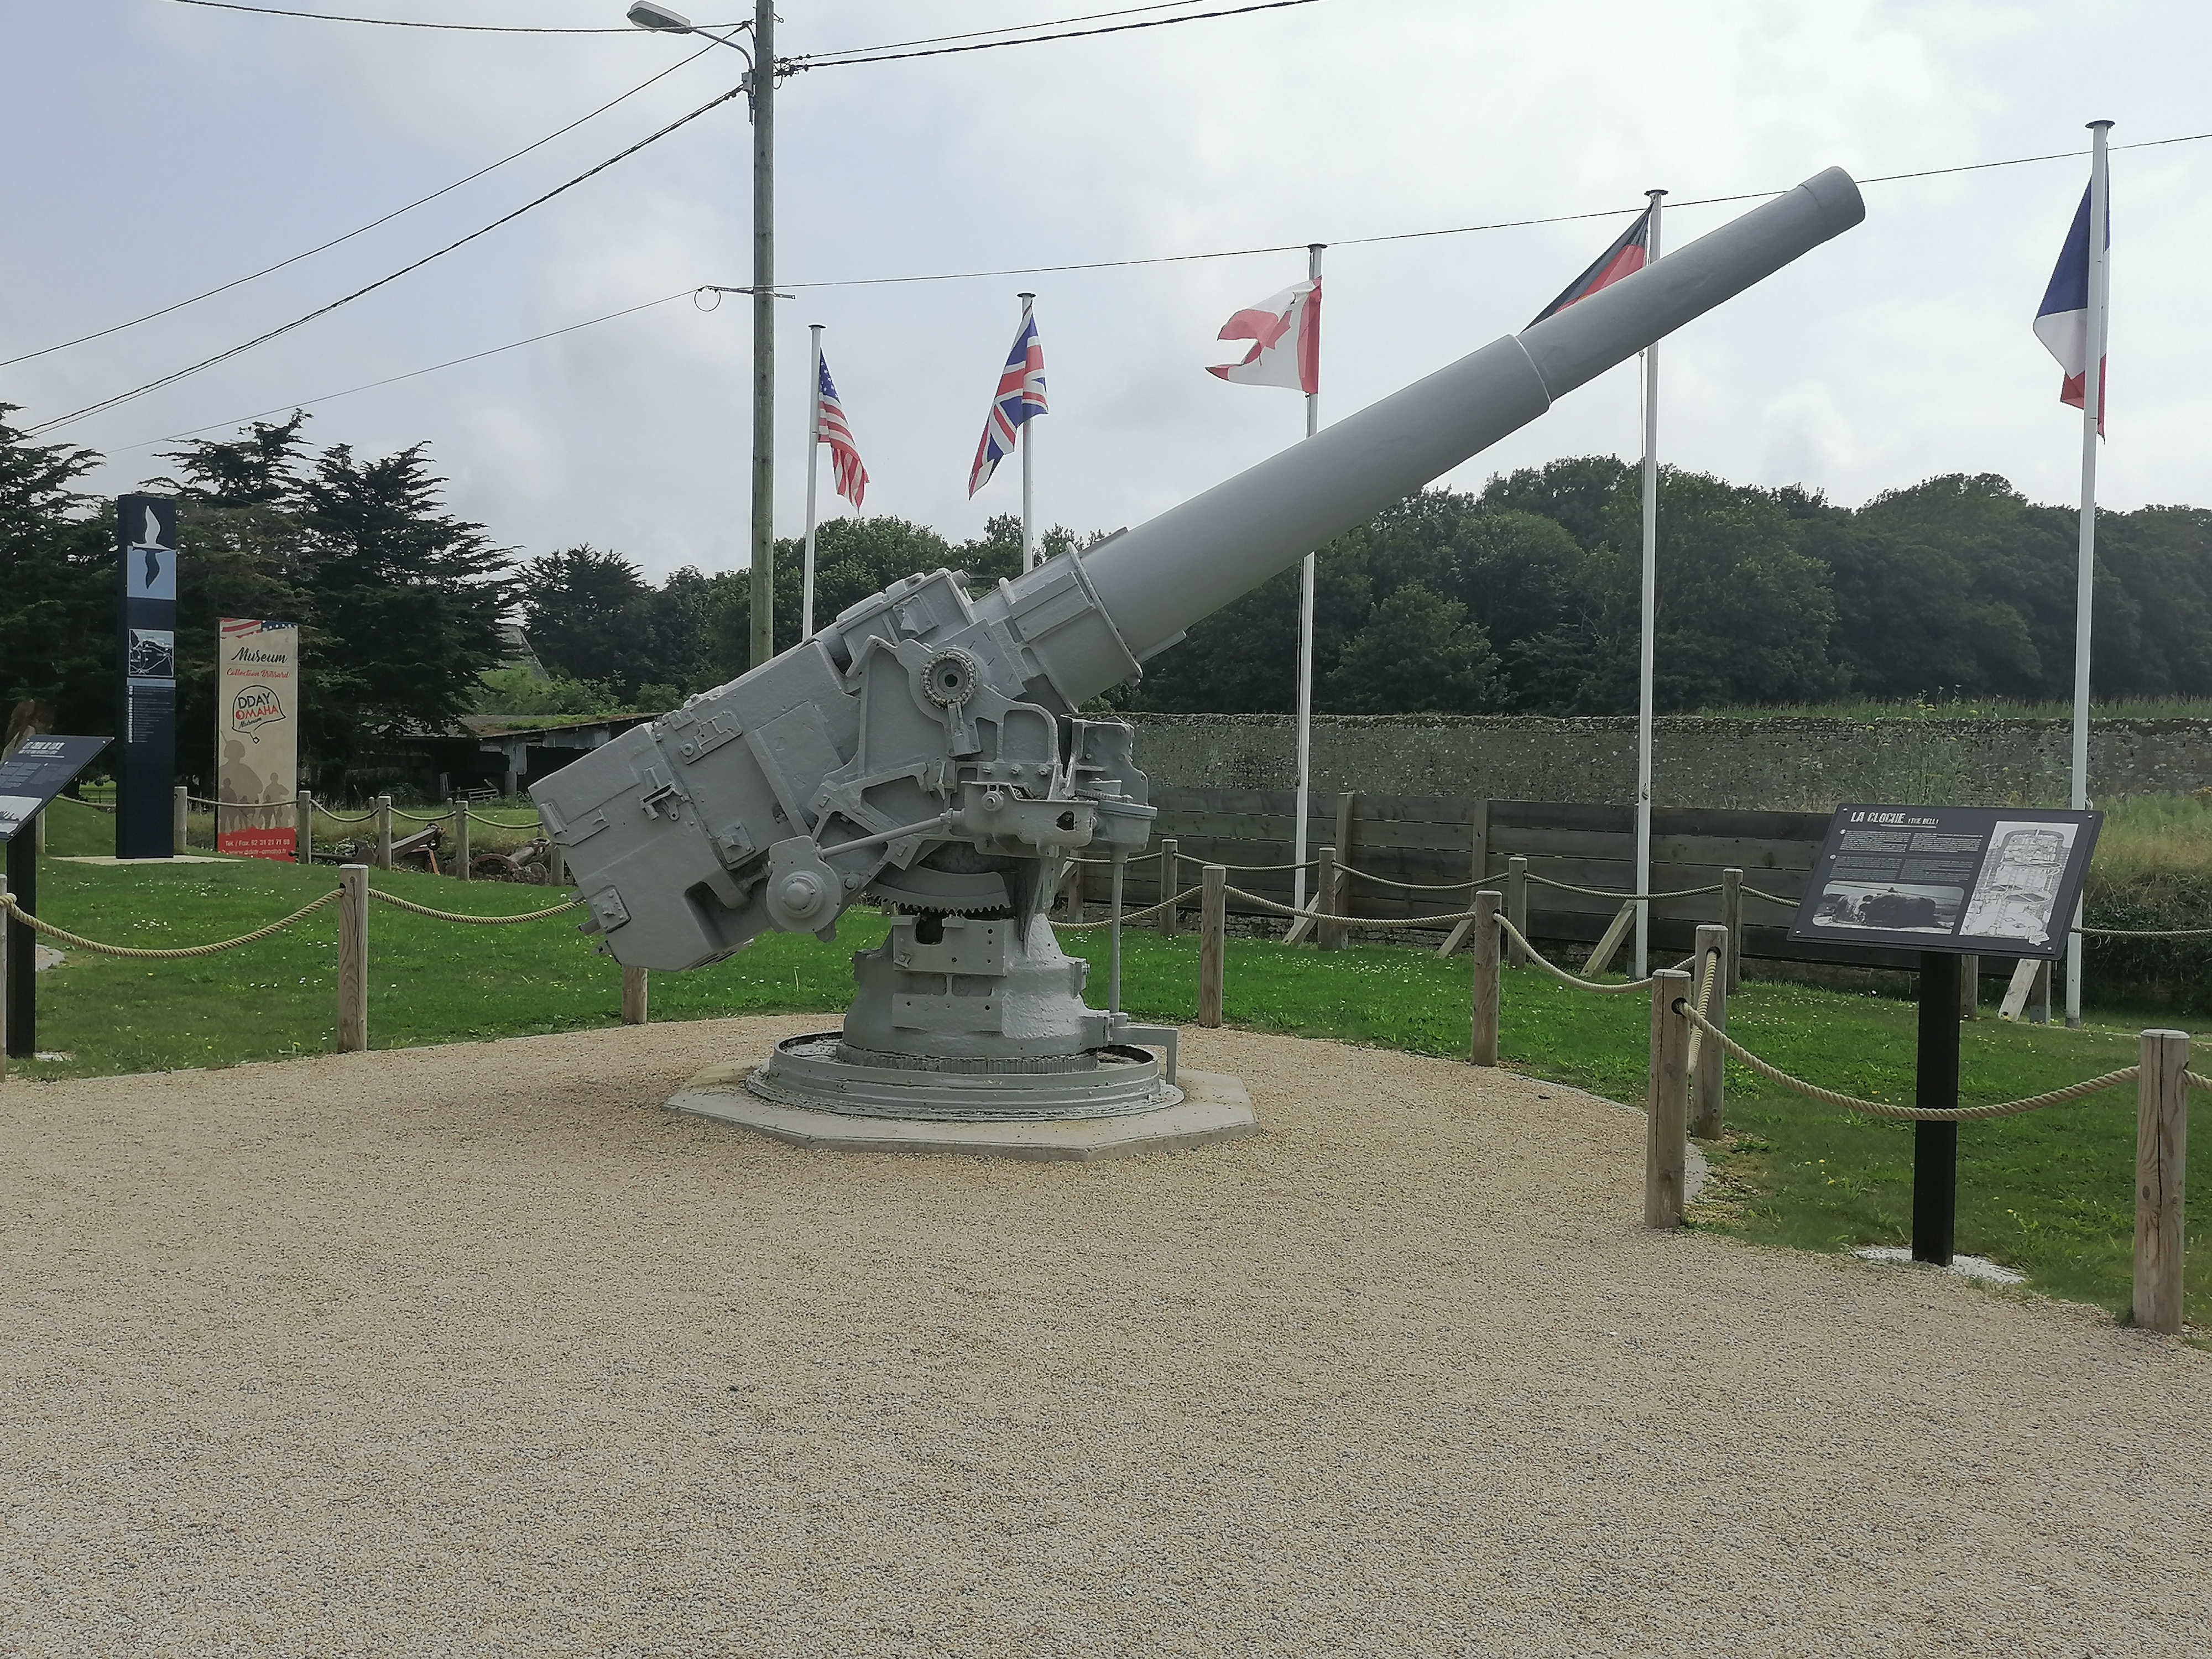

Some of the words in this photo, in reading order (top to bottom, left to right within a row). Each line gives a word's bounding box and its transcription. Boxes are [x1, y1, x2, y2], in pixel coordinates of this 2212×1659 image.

[231, 646, 288, 663] Museum
[227, 668, 259, 677] Collection
[260, 669, 289, 678] Brissard
[238, 692, 270, 709] DDAY
[236, 705, 279, 720] OMAHA
[238, 717, 262, 729] Museum
[1850, 811, 1865, 822] LA
[1867, 812, 1906, 824] CLOCHE
